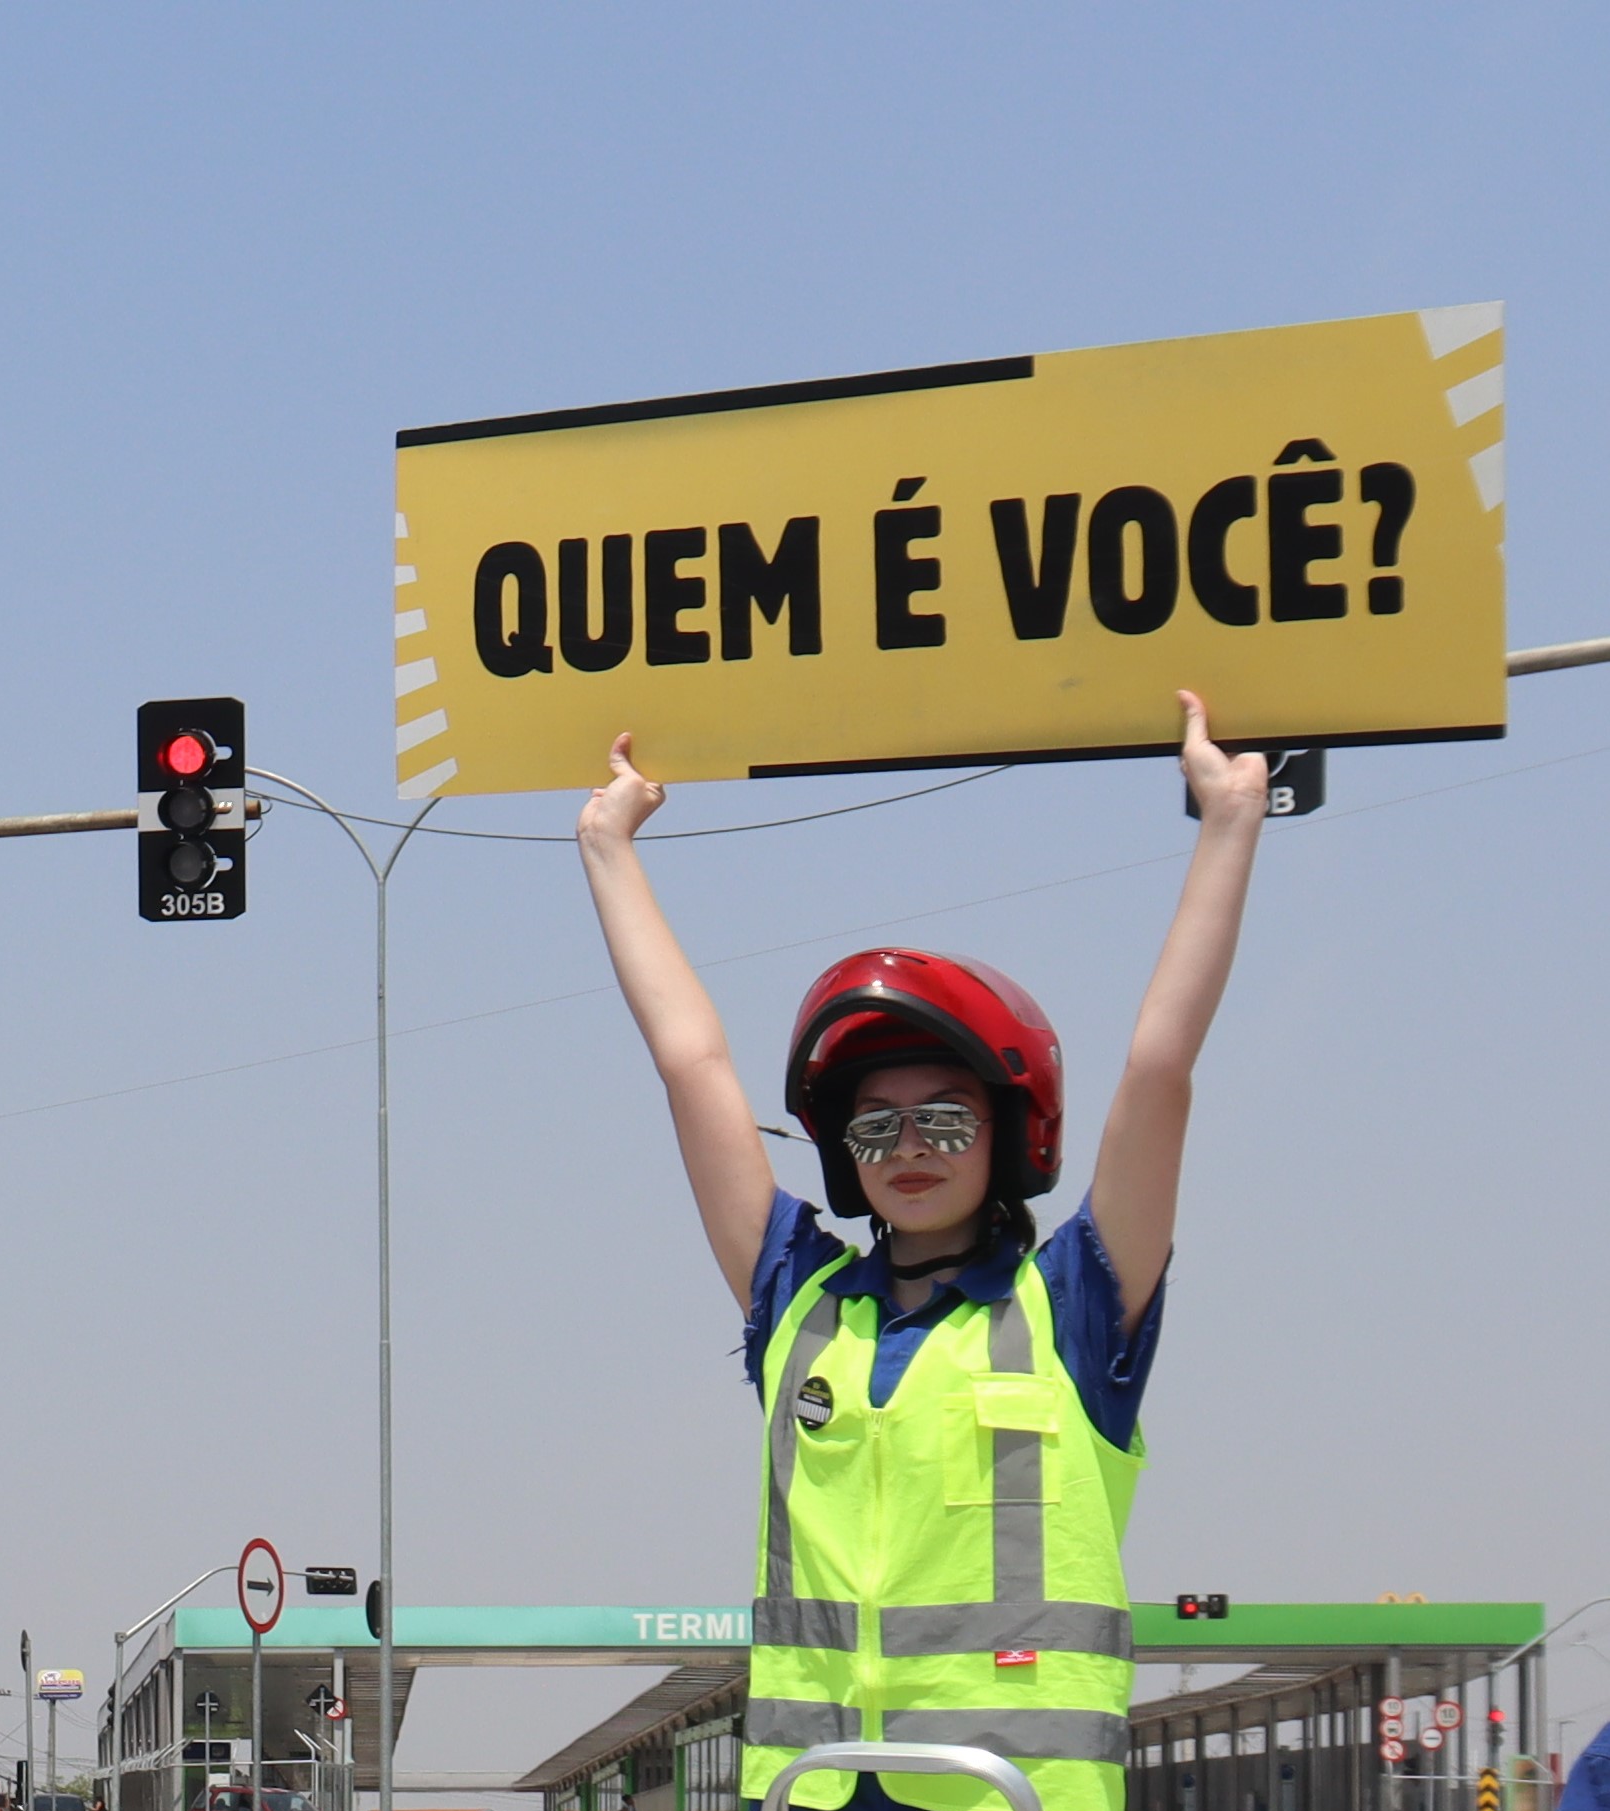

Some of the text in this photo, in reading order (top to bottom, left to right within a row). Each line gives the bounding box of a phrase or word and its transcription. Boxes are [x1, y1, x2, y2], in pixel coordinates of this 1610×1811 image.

[473, 437, 1417, 679] QUEM É VOCÊ?
[160, 891, 226, 917] 305B
